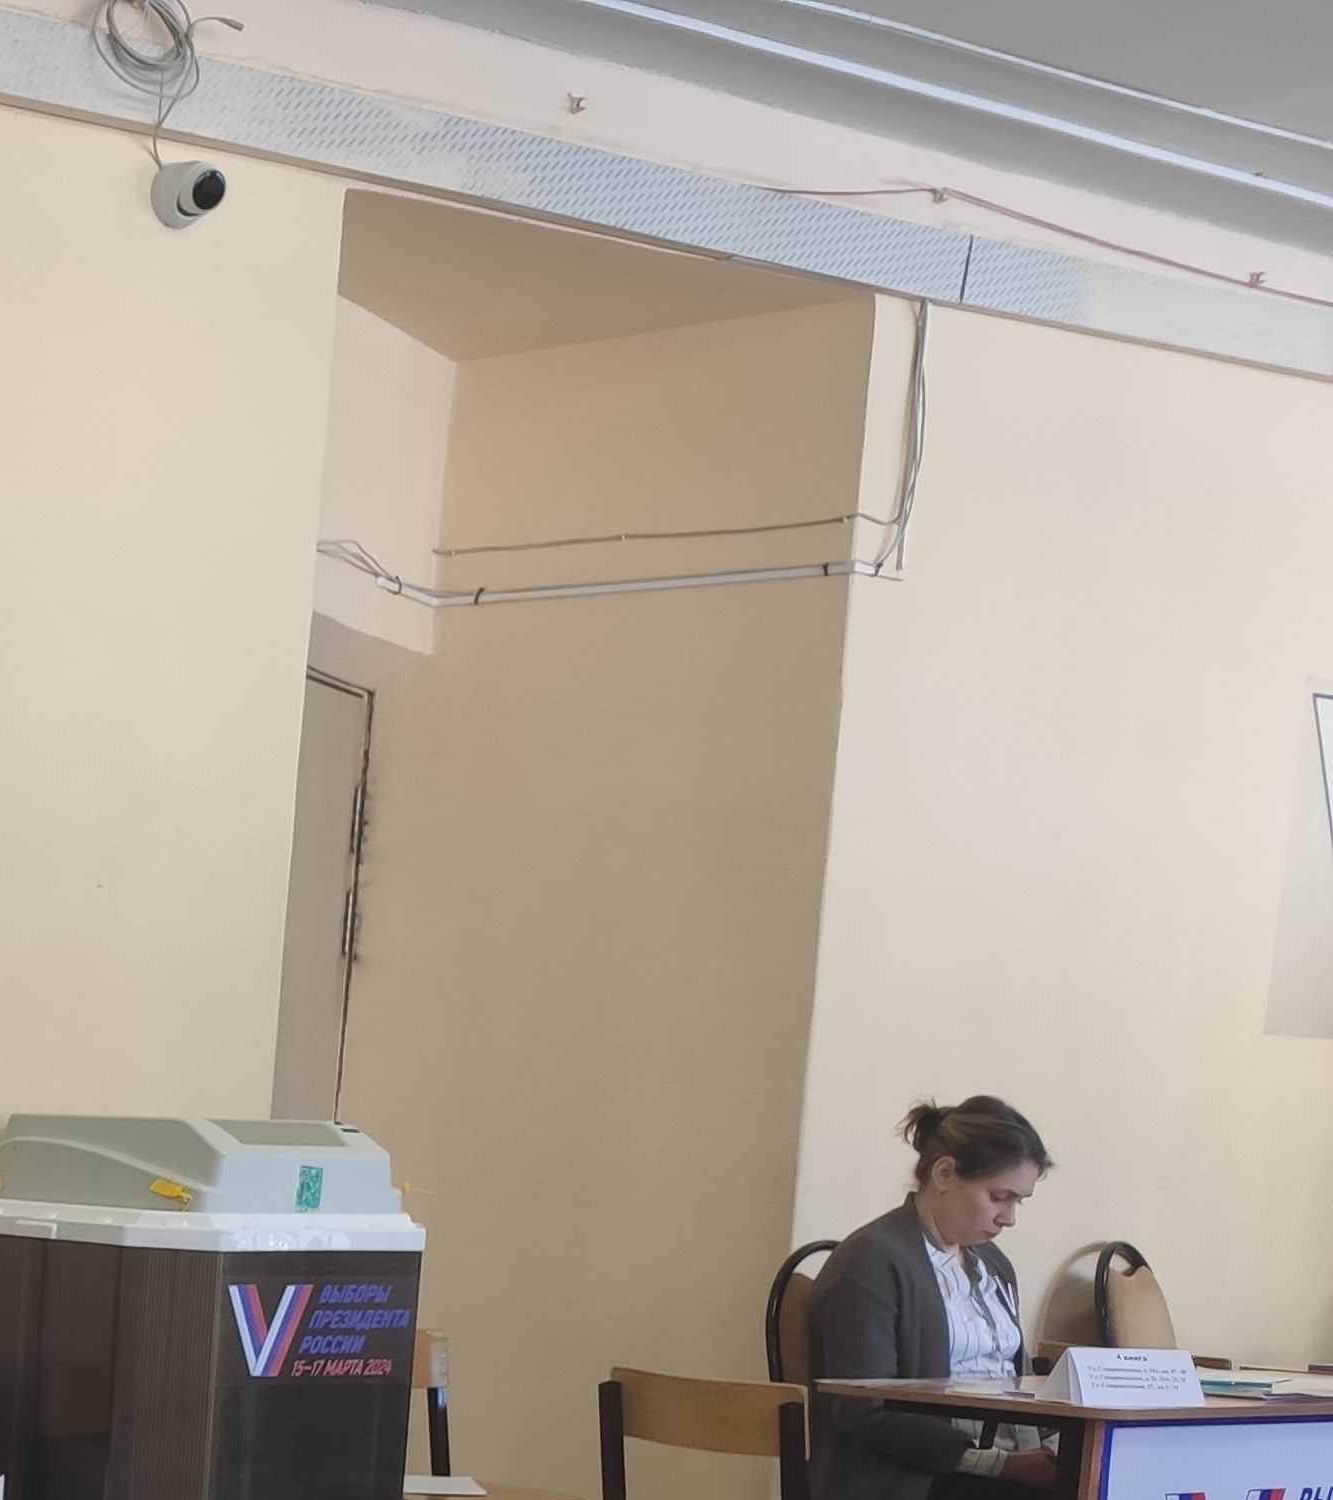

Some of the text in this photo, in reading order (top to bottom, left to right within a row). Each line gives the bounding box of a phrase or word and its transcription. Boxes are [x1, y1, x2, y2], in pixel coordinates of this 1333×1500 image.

[319, 1283, 393, 1304] ВЫБОРЫ
[308, 1308, 412, 1331] ПРЕЗИДЕНТА
[298, 1334, 367, 1355] РОССИИ
[322, 1358, 364, 1376] МАРТА
[363, 1358, 393, 1376] 2024
